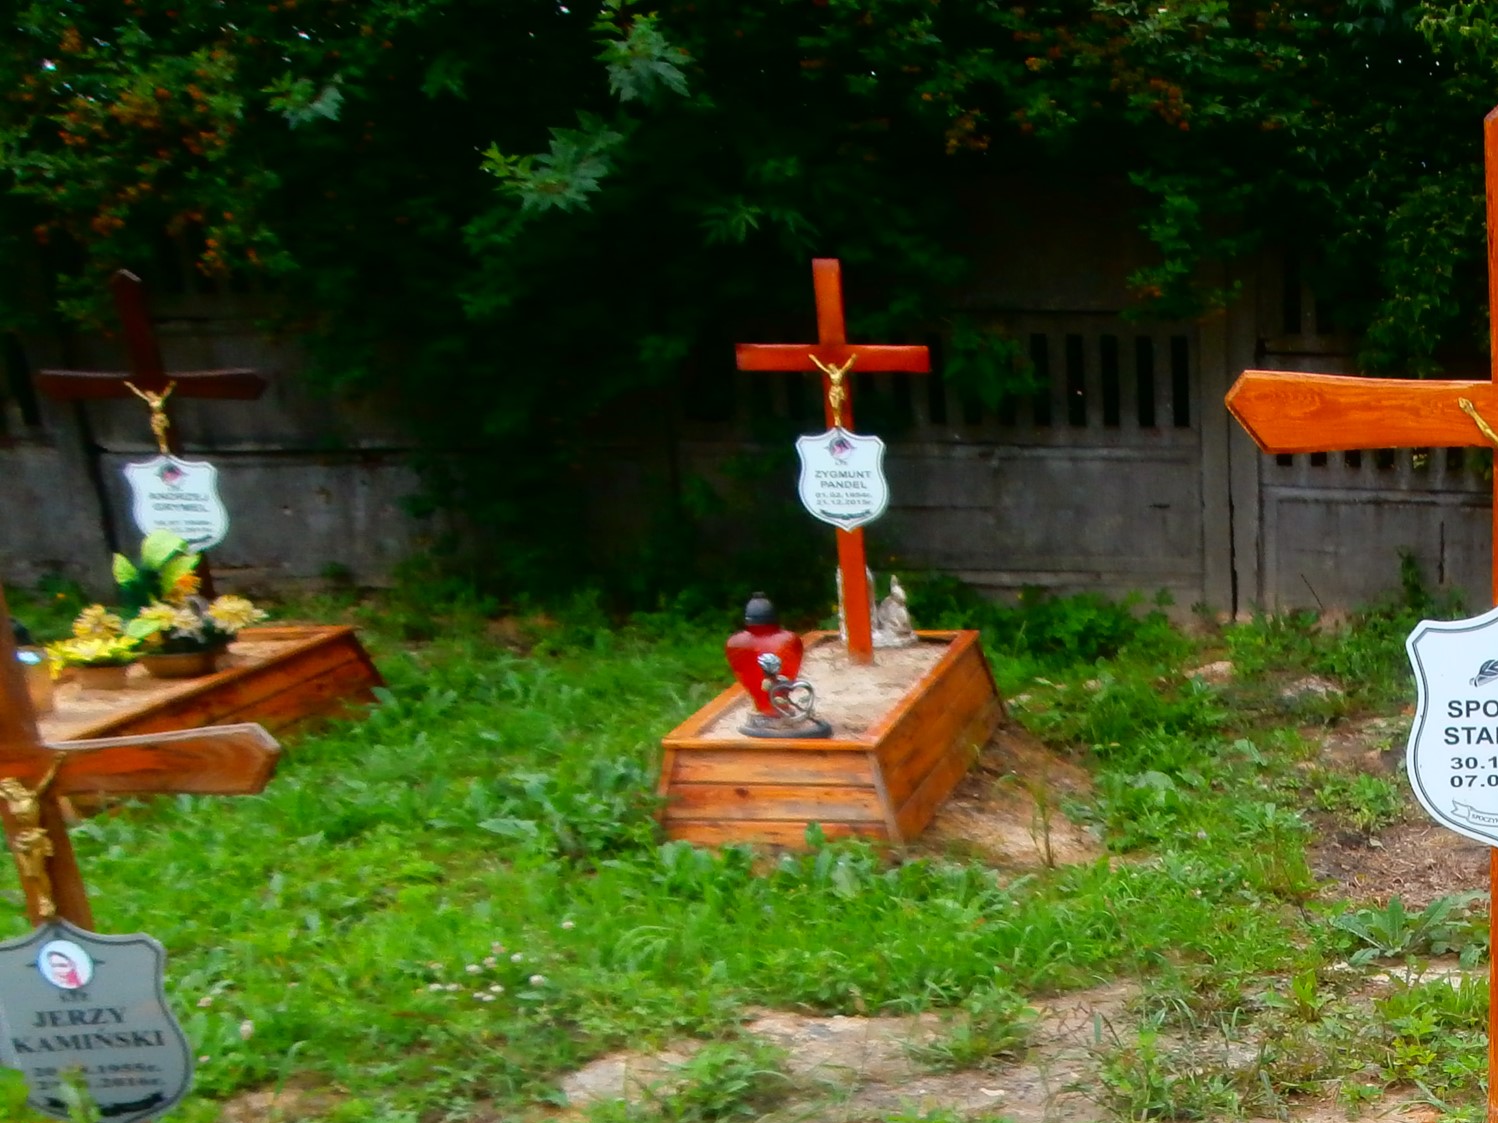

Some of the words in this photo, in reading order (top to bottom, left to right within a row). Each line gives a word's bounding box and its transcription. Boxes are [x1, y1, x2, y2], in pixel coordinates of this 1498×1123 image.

[815, 470, 871, 478] ZYGMUNT
[820, 480, 867, 489] PANDEL
[32, 1007, 126, 1027] JERZY
[11, 1028, 165, 1054] KAMIŃSKI
